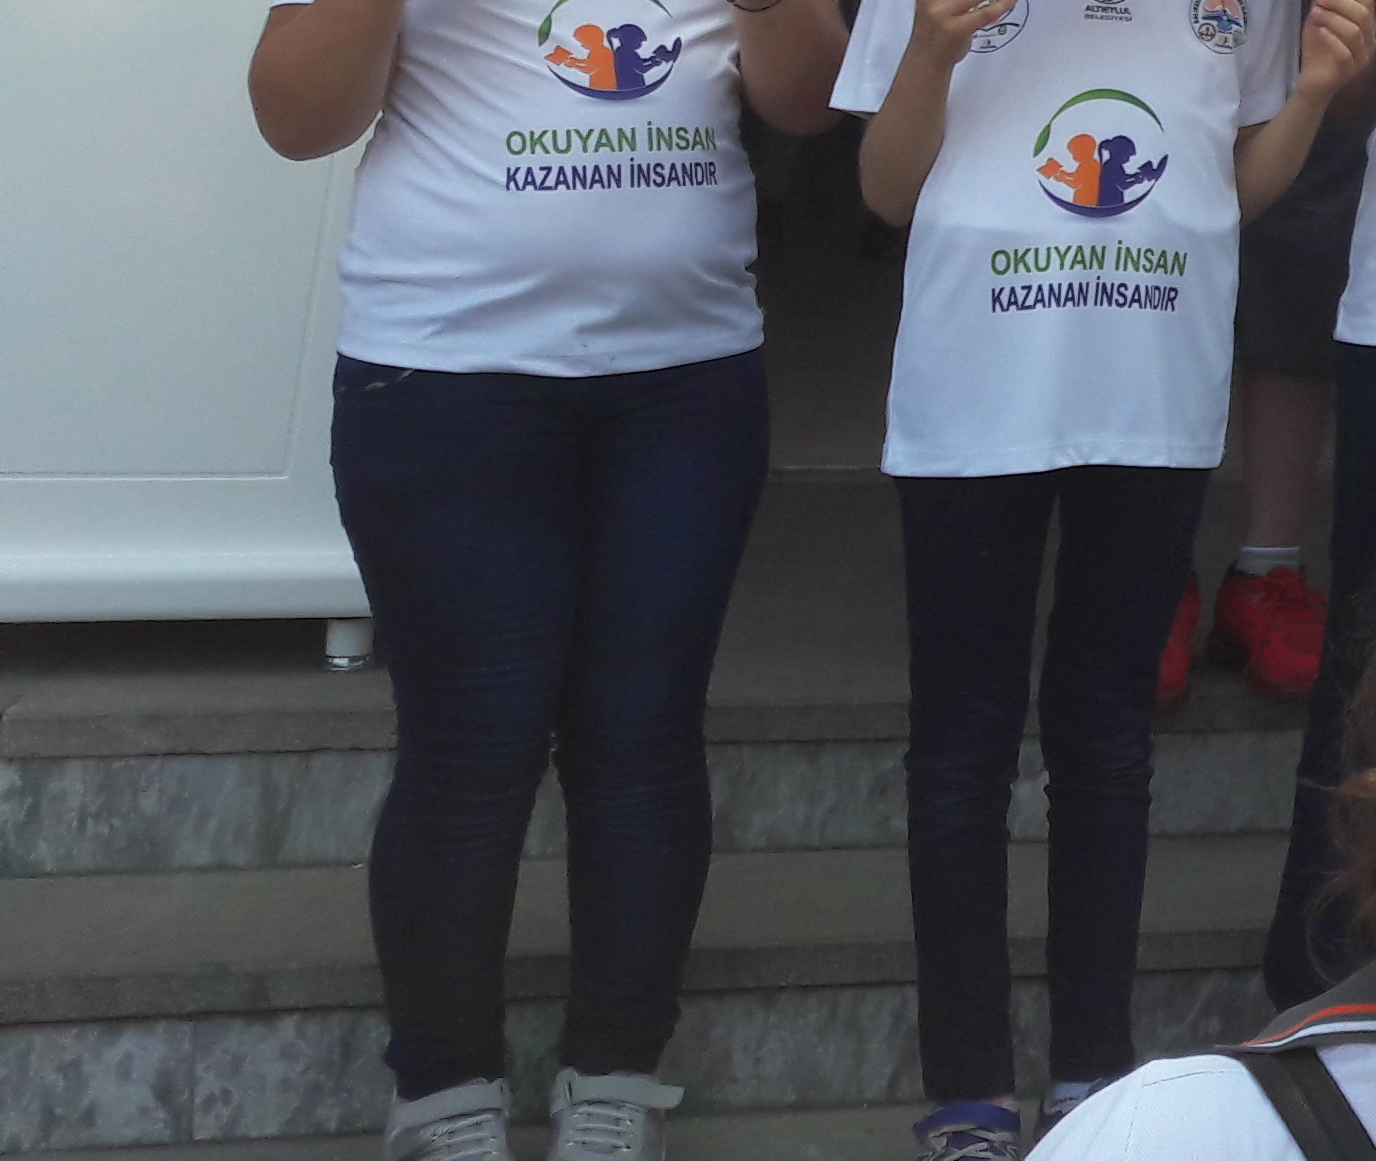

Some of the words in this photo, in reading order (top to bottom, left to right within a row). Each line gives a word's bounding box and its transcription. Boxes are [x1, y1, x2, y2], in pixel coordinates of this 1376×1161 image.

[505, 127, 637, 155] OKUYAN
[646, 121, 717, 152] İNSAN
[505, 162, 621, 191] KAZANAN
[629, 157, 718, 189] İNSANDIR
[990, 245, 1107, 276] OKUYAN
[1115, 240, 1187, 276] İNSAN
[991, 282, 1090, 314] KAZANAN
[1094, 276, 1179, 312] İNSANDIR
